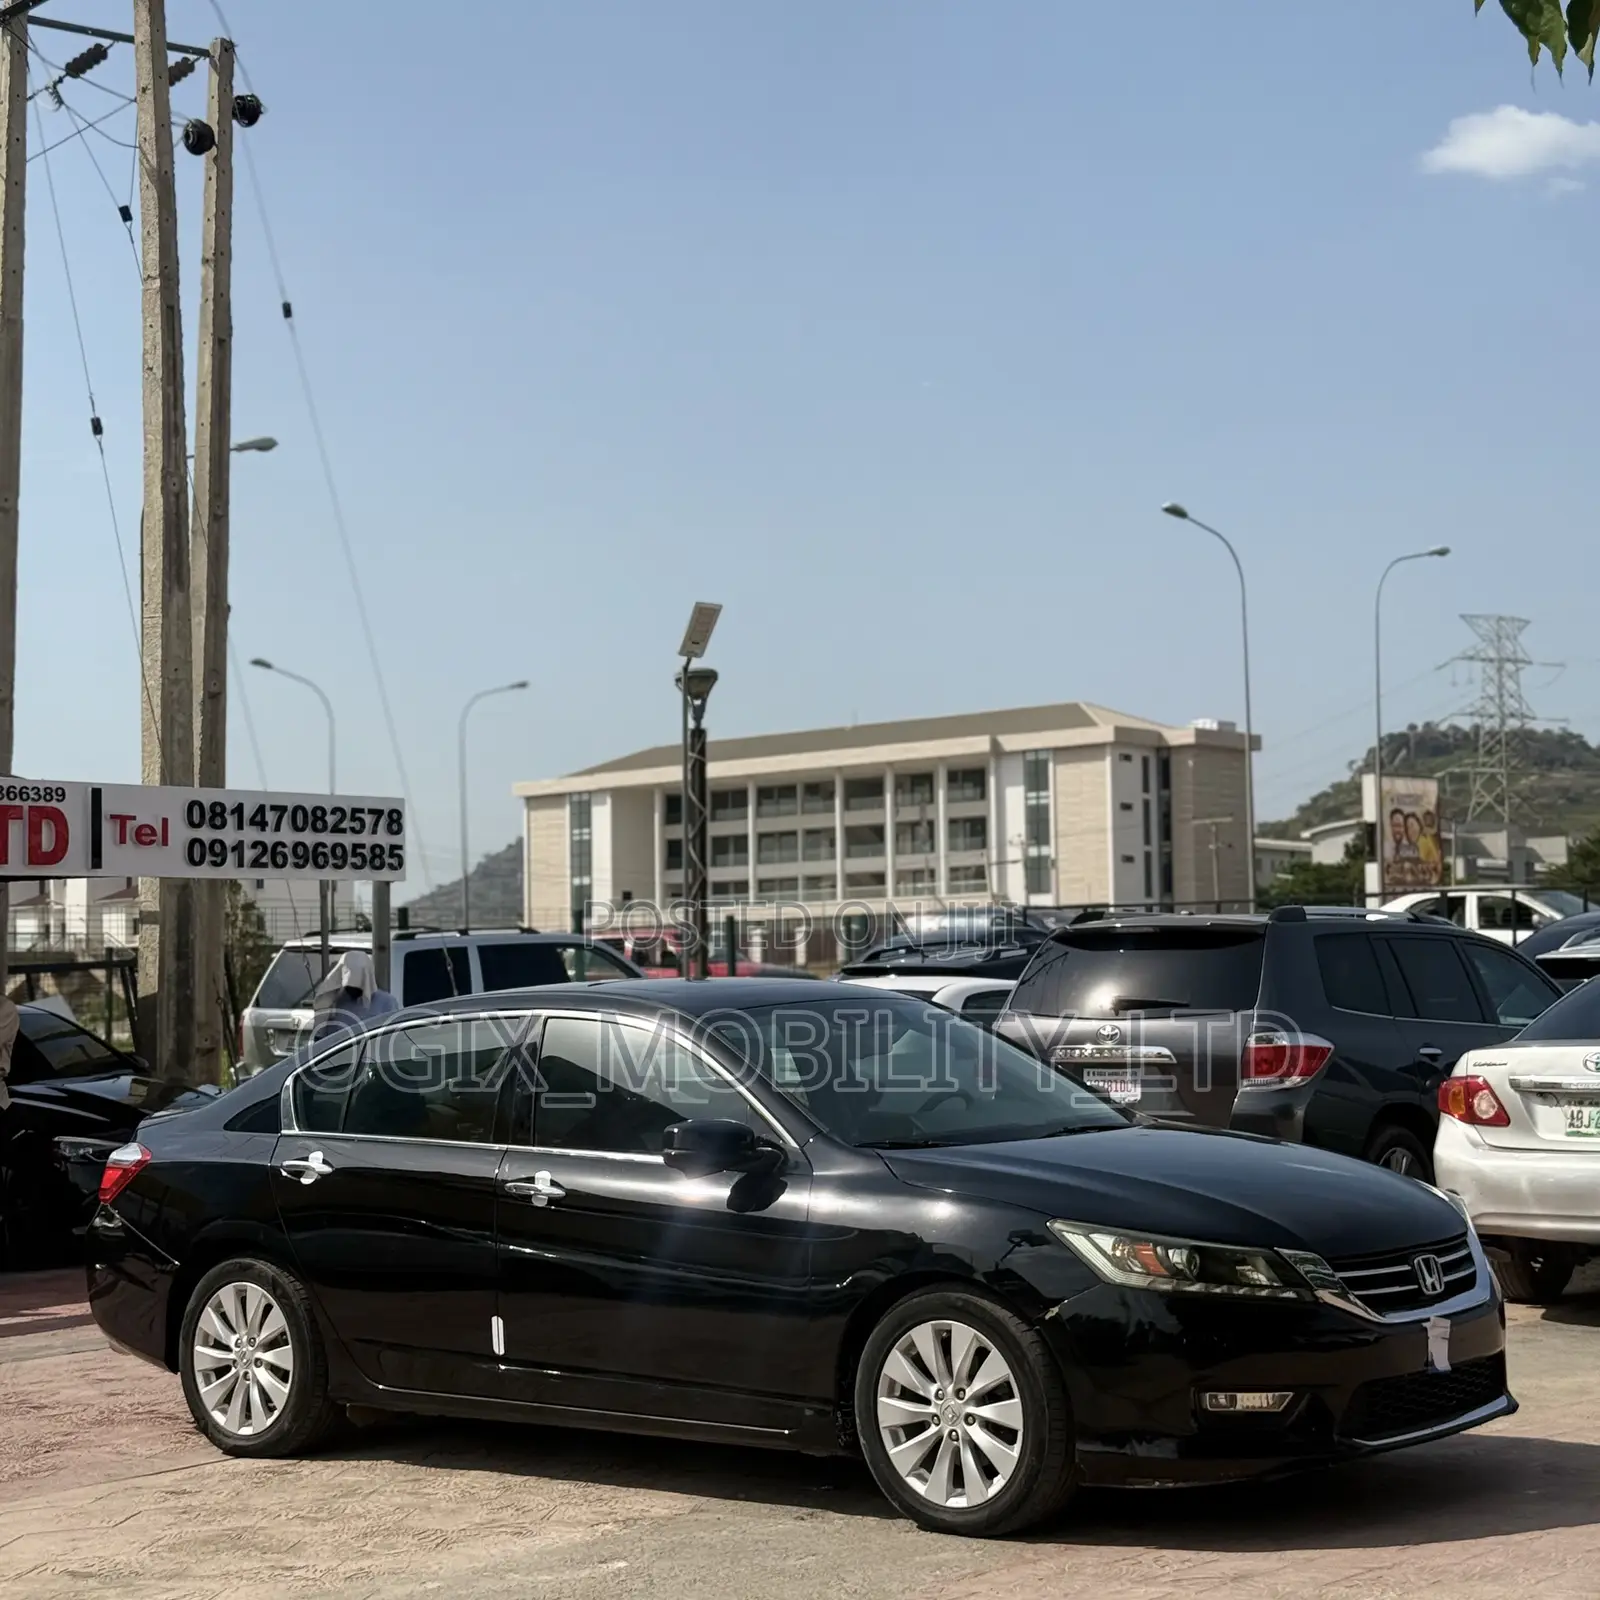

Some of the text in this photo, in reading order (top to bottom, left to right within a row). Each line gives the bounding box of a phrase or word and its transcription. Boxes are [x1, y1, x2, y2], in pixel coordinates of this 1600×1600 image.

[109, 813, 169, 847] Tel
[186, 800, 403, 836] 08147082578
[187, 837, 404, 872] 09126969585
